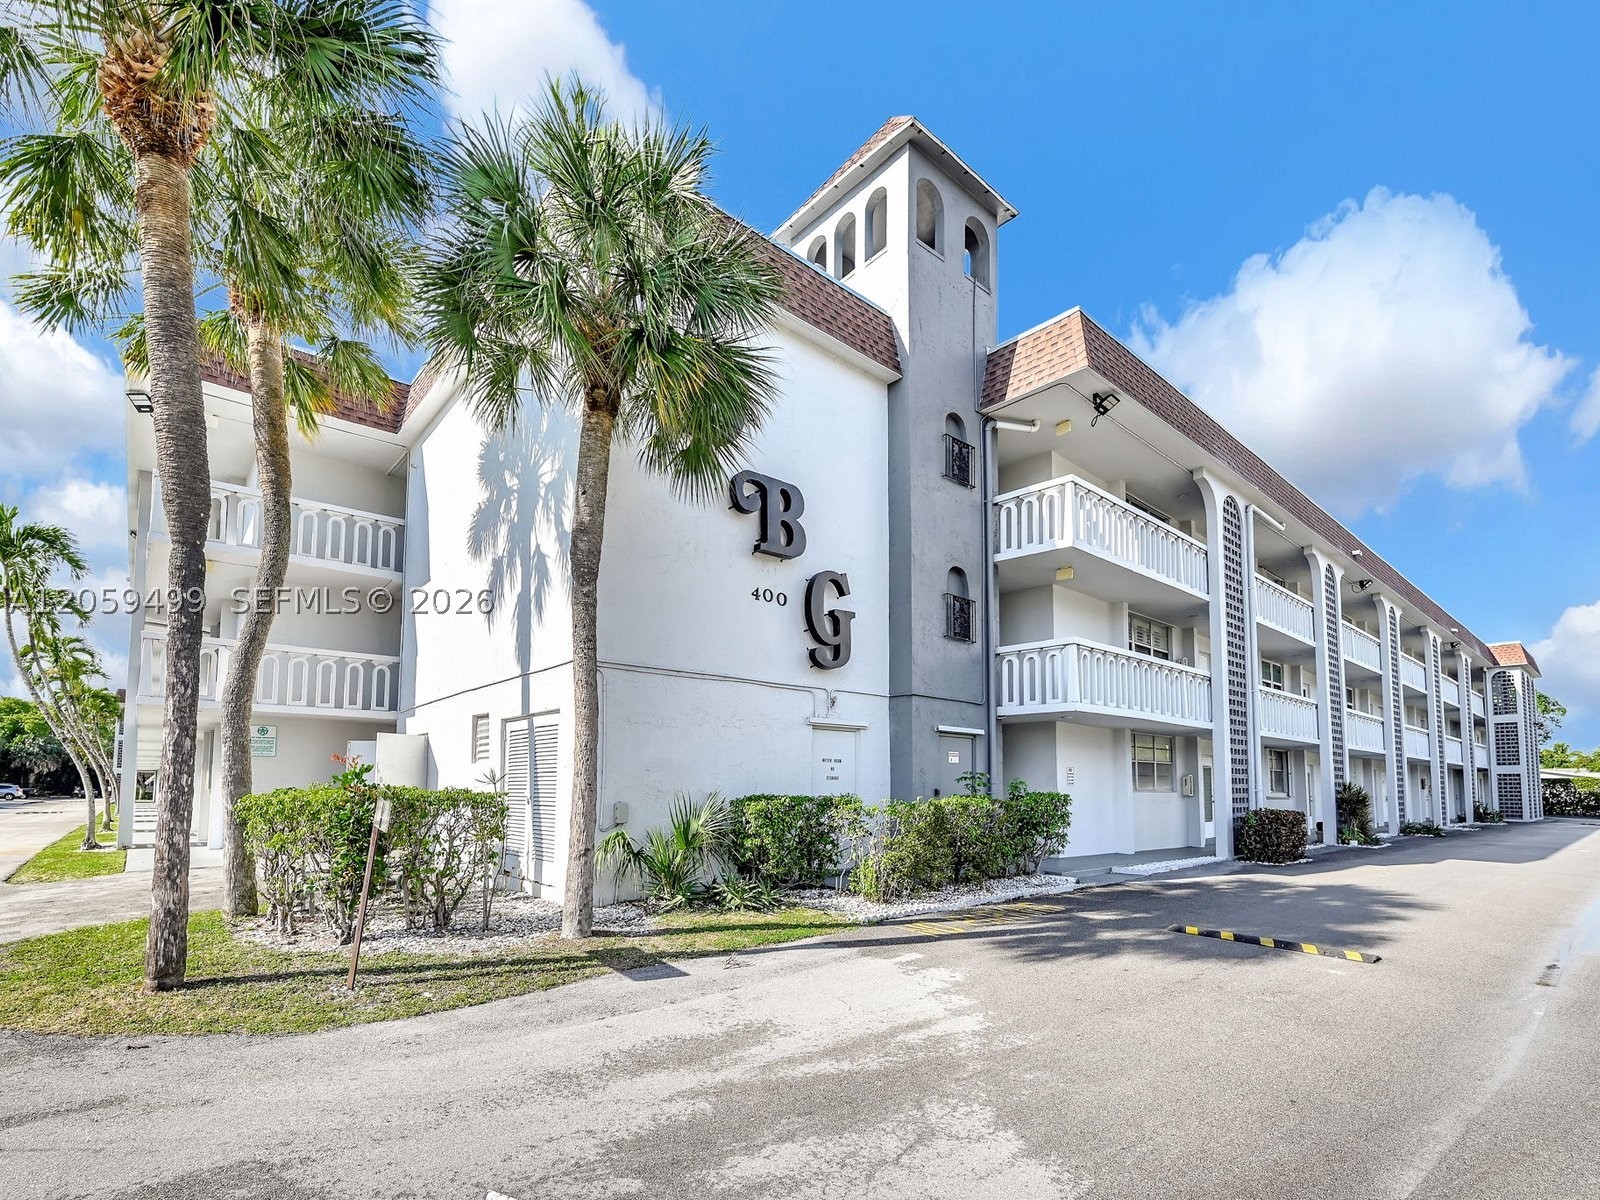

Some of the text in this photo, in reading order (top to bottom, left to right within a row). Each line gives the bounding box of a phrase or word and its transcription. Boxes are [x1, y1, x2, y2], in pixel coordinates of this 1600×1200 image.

[729, 469, 807, 560] B
[751, 587, 788, 606] 400
[804, 570, 856, 670] G
